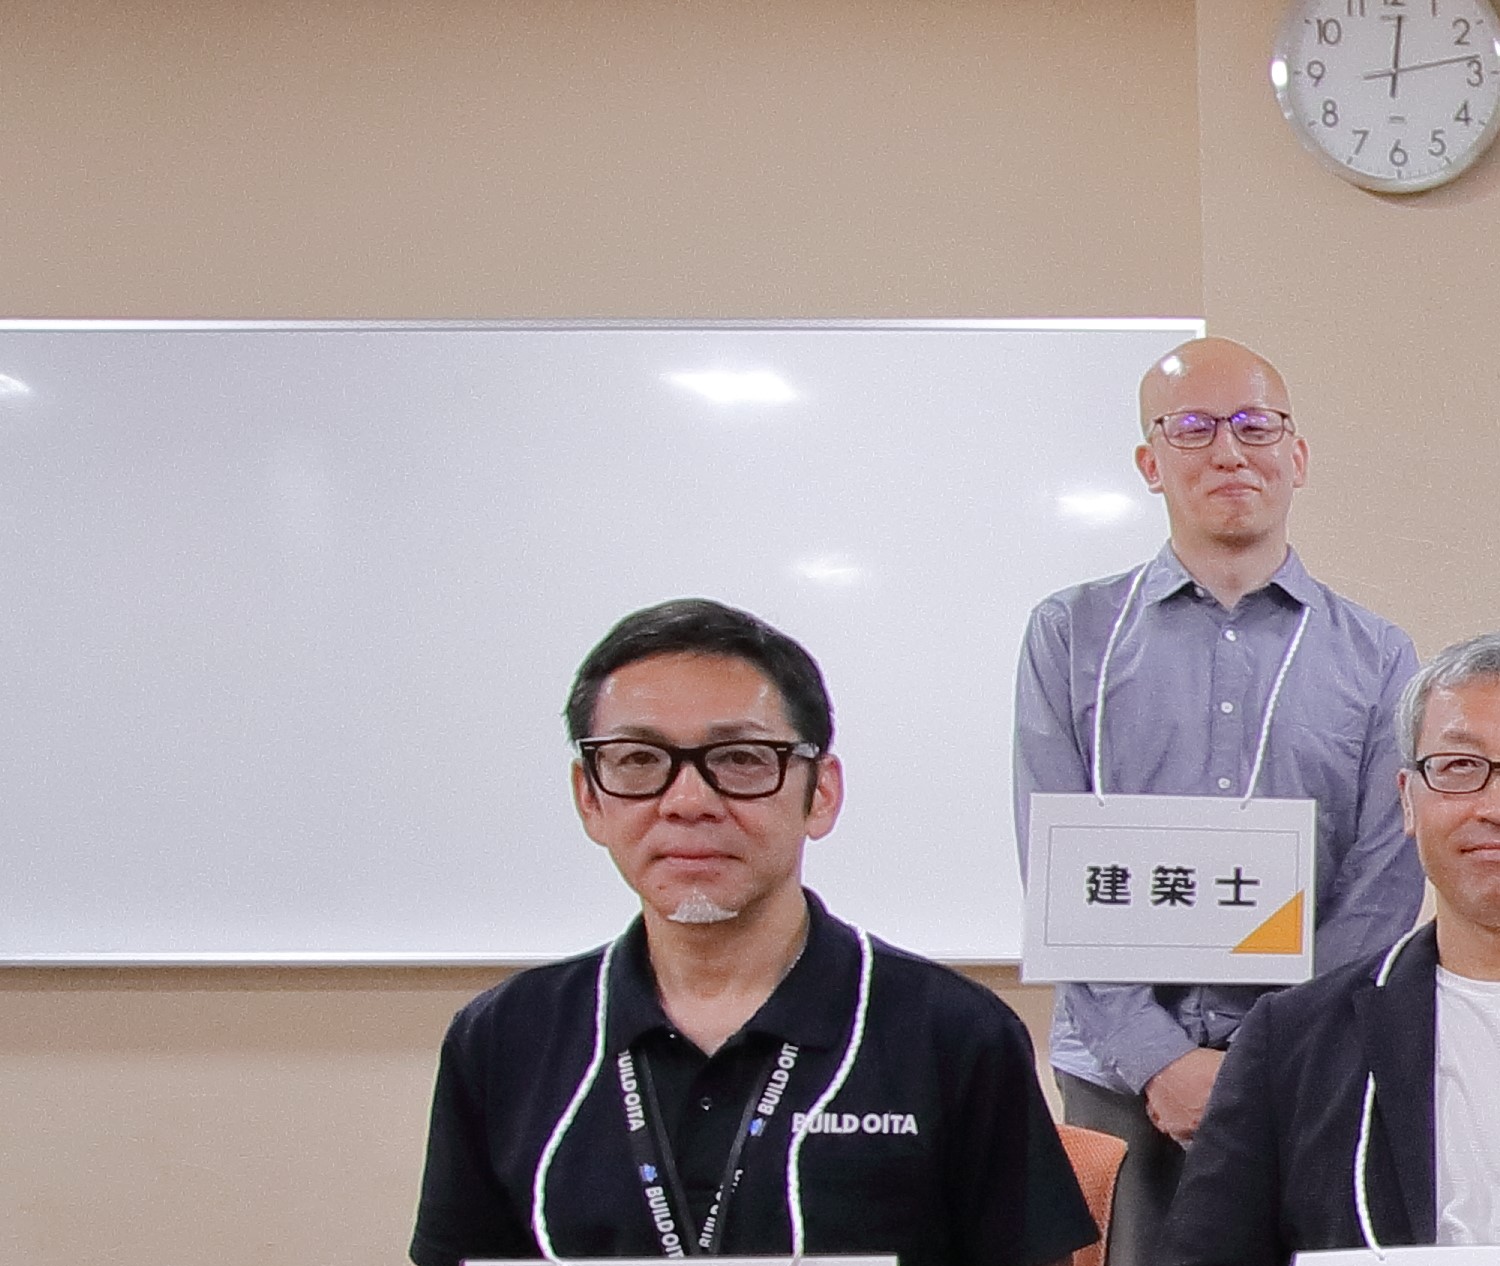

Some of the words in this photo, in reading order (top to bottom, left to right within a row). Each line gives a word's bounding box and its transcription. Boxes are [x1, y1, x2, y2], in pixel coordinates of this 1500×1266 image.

[1316, 18, 1342, 45] 10
[1452, 18, 1470, 45] 2
[1306, 60, 1326, 87] 9
[1466, 60, 1483, 87] 3
[1321, 100, 1339, 127] 8
[1454, 101, 1472, 126] 4
[1351, 129, 1369, 155] 7
[1389, 139, 1408, 168] 6
[1428, 129, 1447, 156] 5
[1085, 865, 1260, 906] 建築士
[757, 1068, 790, 1116] BUILD
[777, 1042, 799, 1070] OIT
[624, 1092, 645, 1132] OITA
[861, 1111, 919, 1136] OITA
[645, 1186, 675, 1233] BUILD
[661, 1232, 685, 1258] OIT
